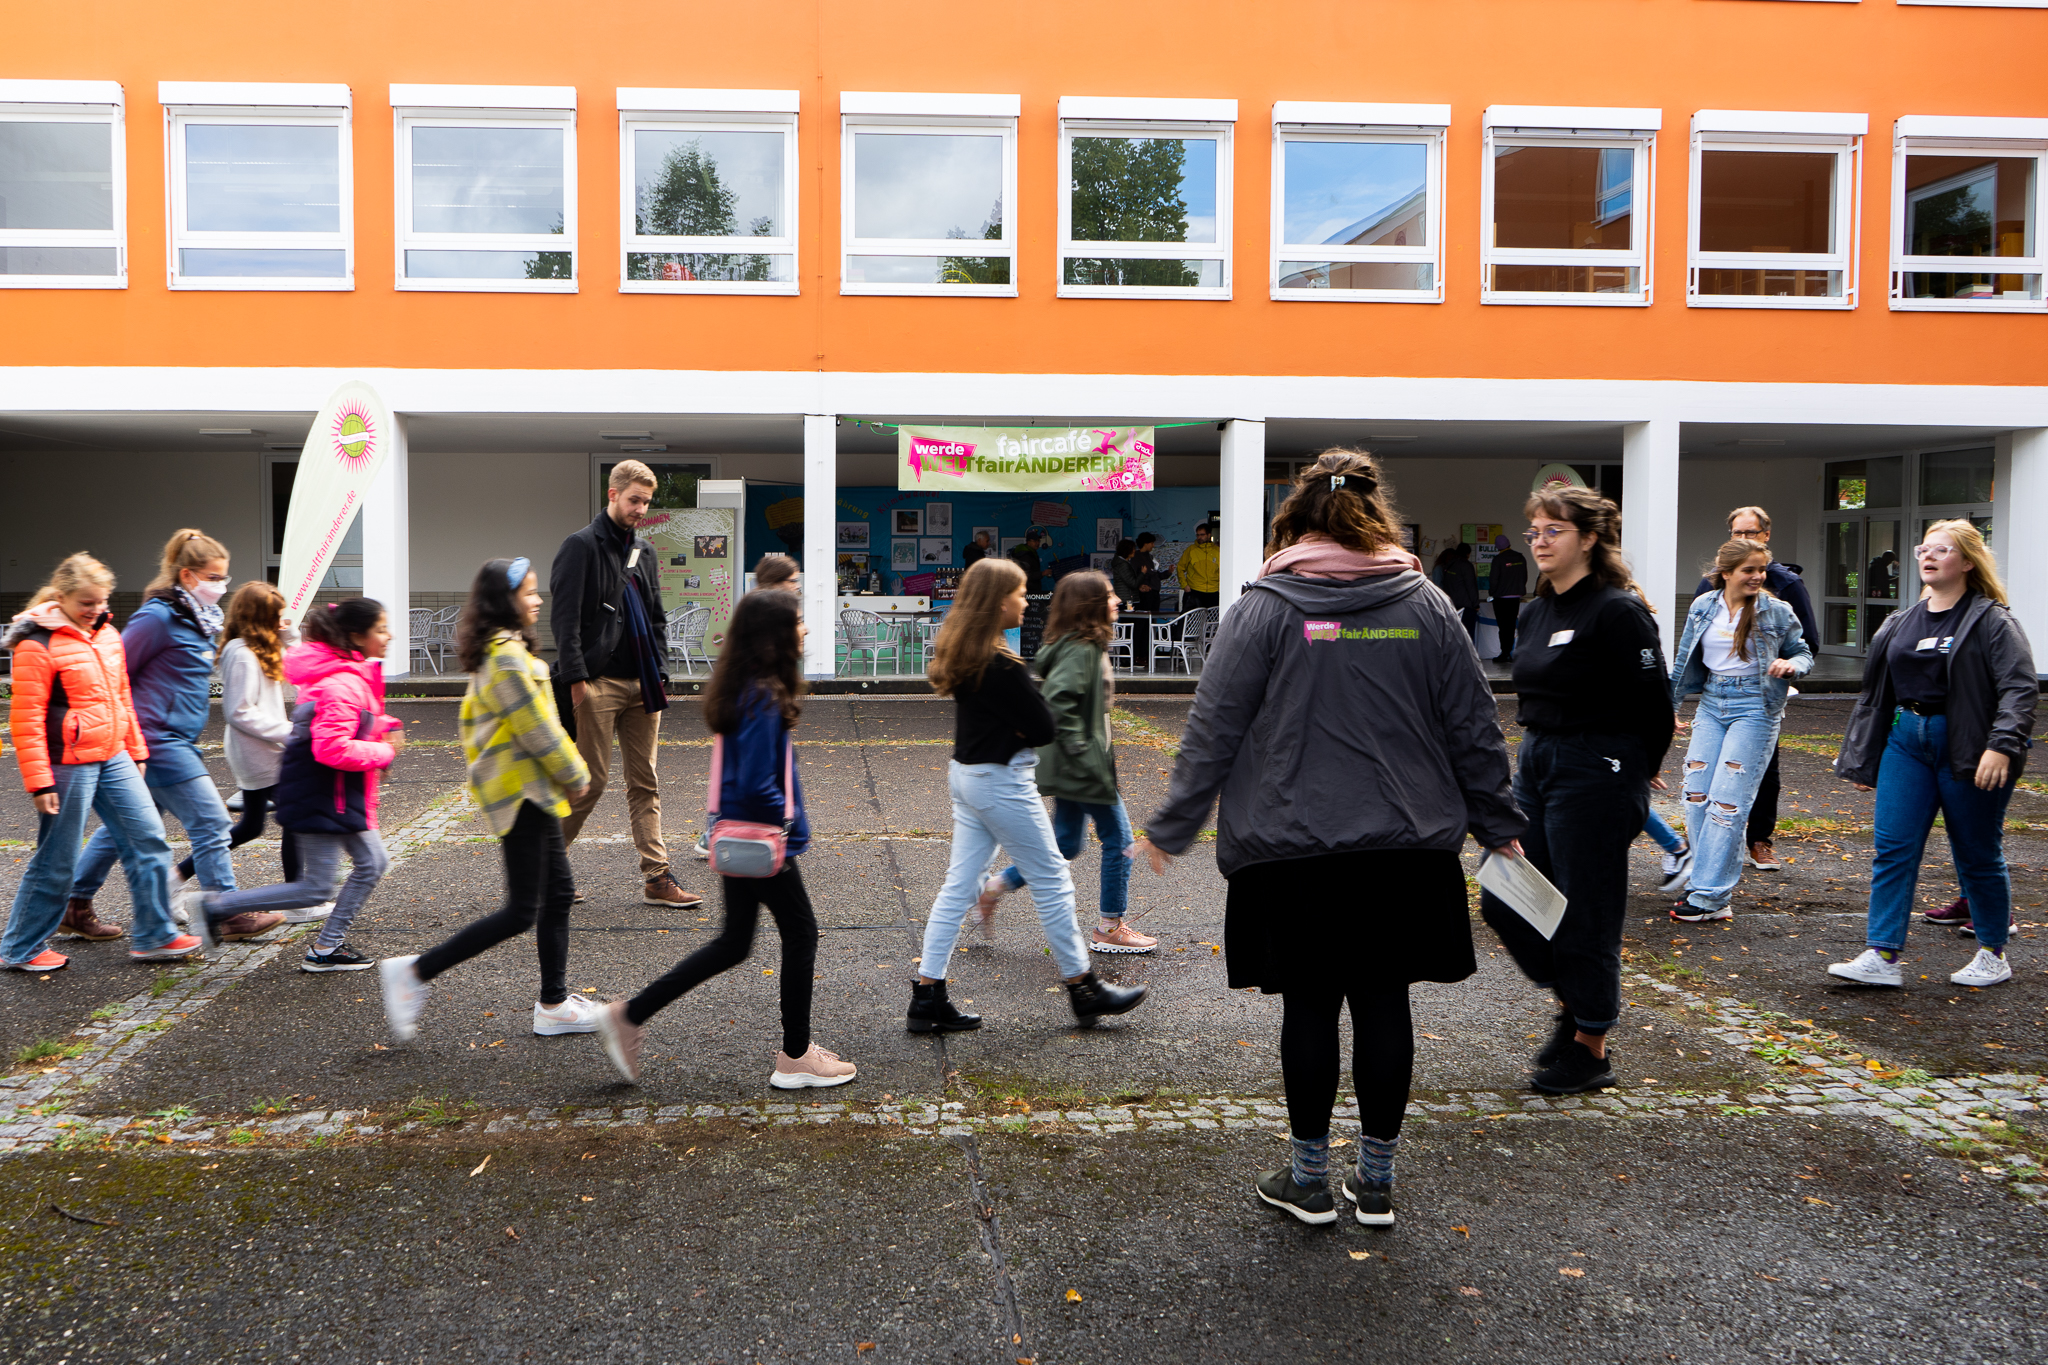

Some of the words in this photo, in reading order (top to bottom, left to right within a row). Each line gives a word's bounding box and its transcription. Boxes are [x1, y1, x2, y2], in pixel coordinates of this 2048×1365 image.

[914, 442, 965, 456] werde
[996, 429, 1092, 459] faircafé
[919, 454, 1124, 474] WELTfairÄNDERER!
[836, 497, 870, 520] ährung
[290, 489, 357, 611] www.weltfairänderer.de
[1306, 621, 1335, 631] Werde
[1310, 627, 1419, 640] WELTfairÄNDERER!
